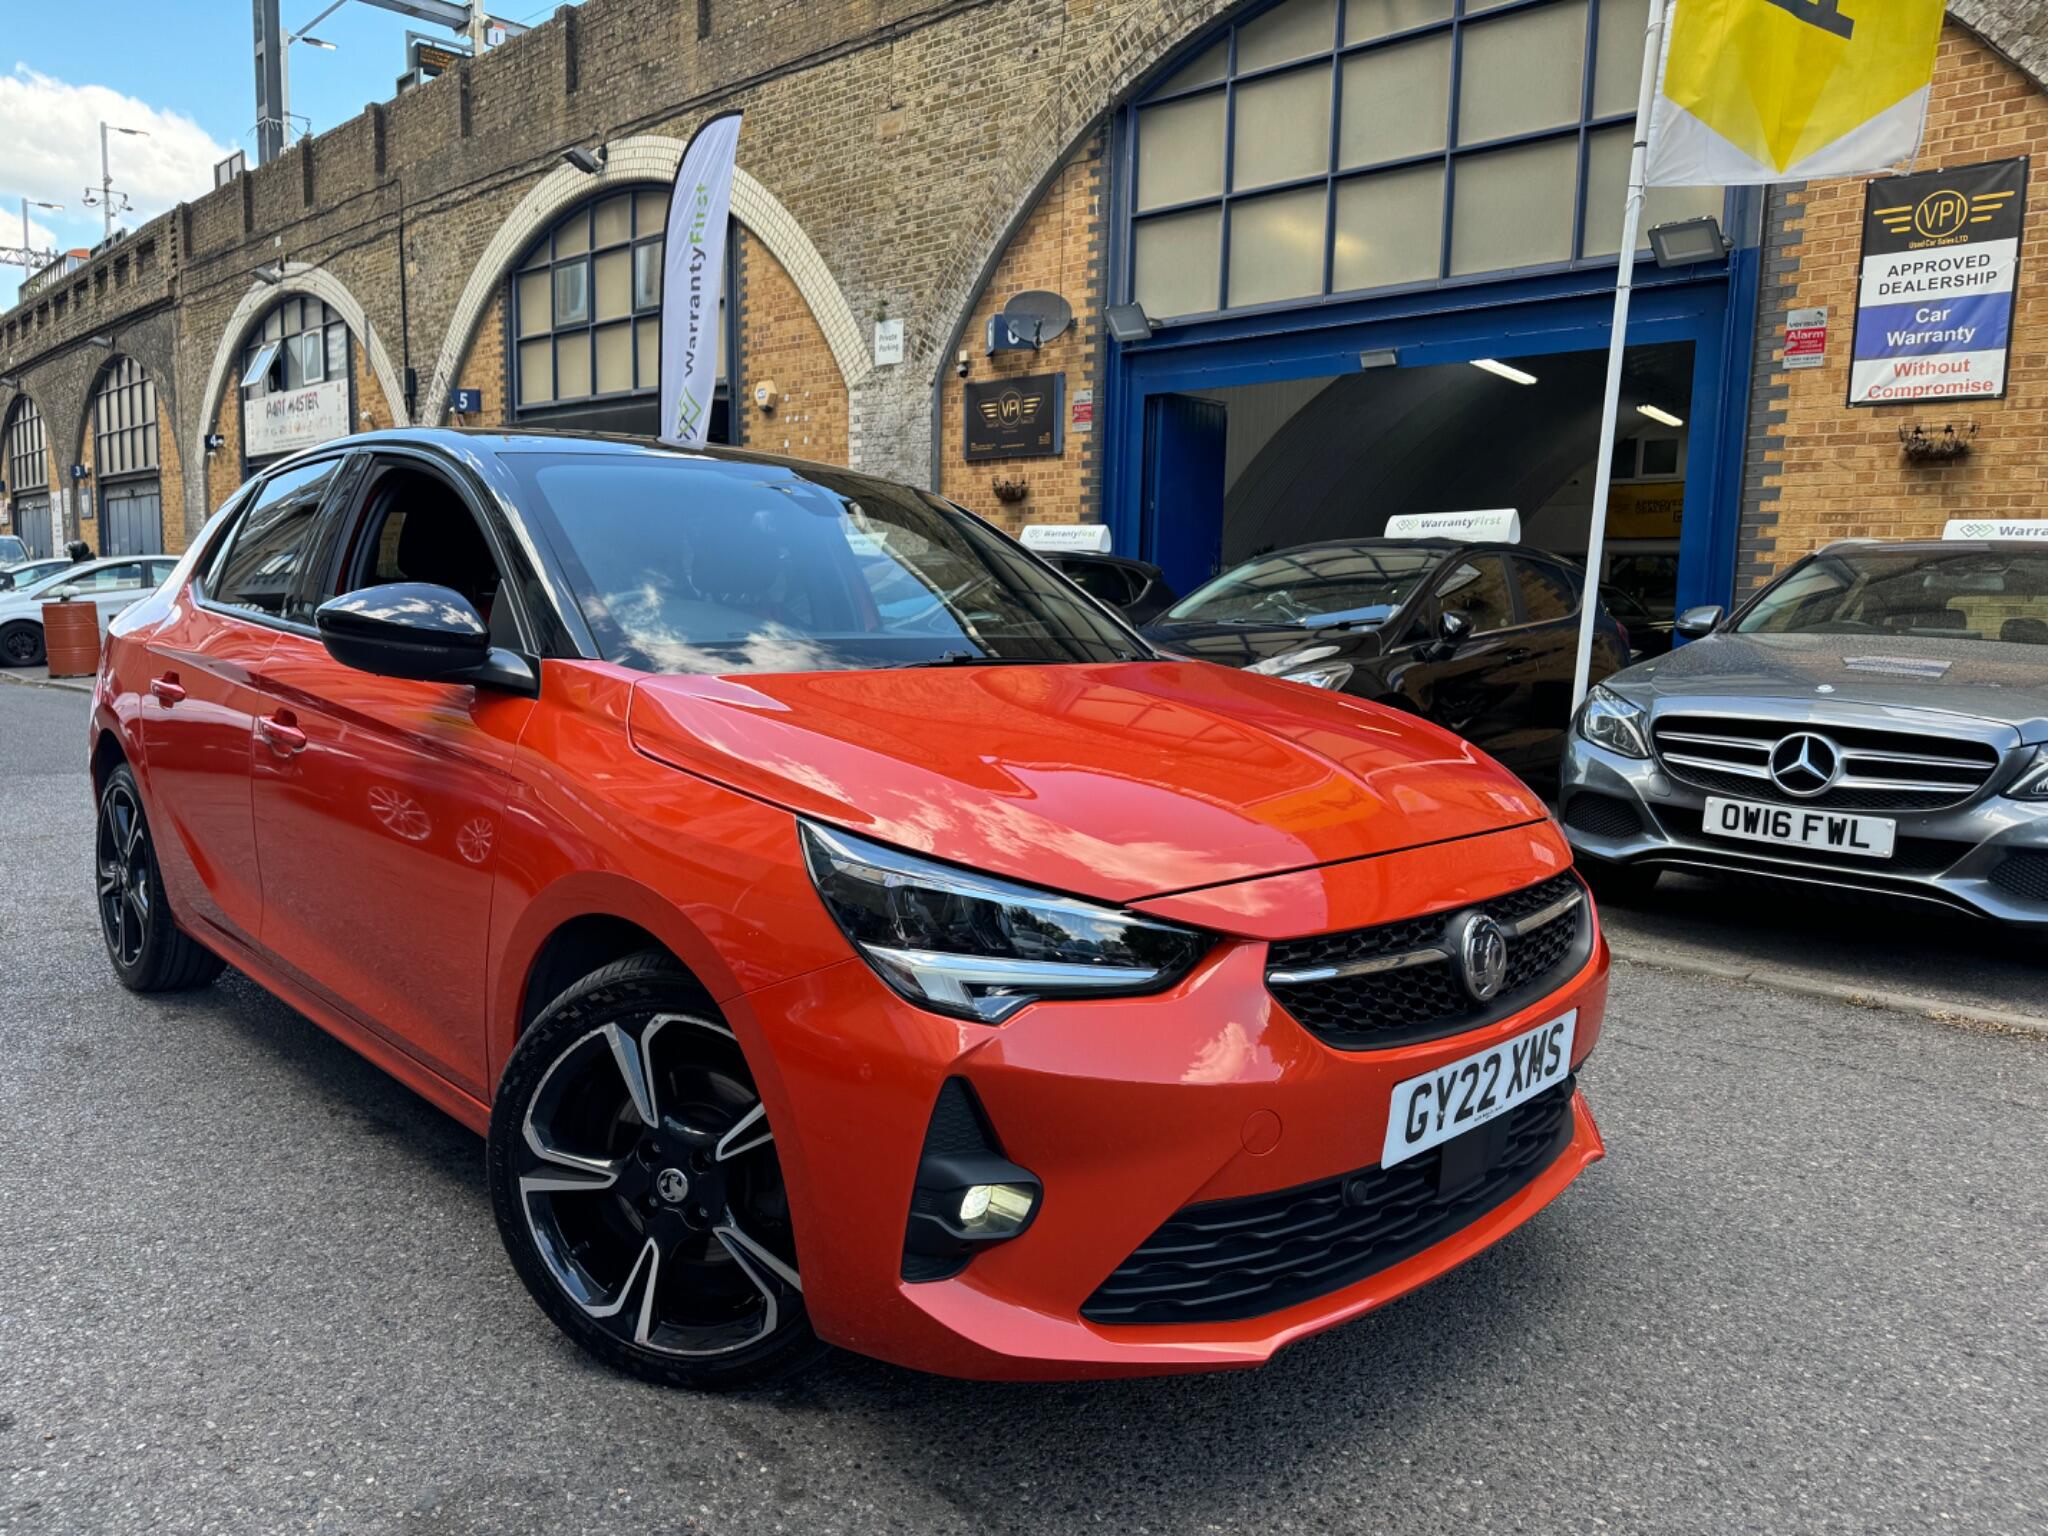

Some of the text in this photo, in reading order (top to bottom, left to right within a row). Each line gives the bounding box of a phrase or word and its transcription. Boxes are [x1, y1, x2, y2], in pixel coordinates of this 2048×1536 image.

[1923, 199, 1962, 229] VPI
[1908, 234, 1969, 249] Used Car Sales LTD
[1886, 254, 1991, 277] APPROVED
[685, 182, 708, 378] WarrantyFirst
[1879, 271, 1998, 296] DEALERSHIP
[1915, 308, 1951, 324] Car
[1788, 331, 1824, 340] Alarm
[1886, 326, 1976, 347] Warranty
[1894, 359, 1970, 378] Without
[1868, 379, 1993, 399] Compromise
[458, 392, 468, 410] 5
[1420, 517, 1501, 529] WarrantyFirst
[1999, 526, 2048, 536] Warra
[1722, 803, 1870, 849] OW16 FWL
[1405, 1022, 1564, 1144] GY22 XMS
